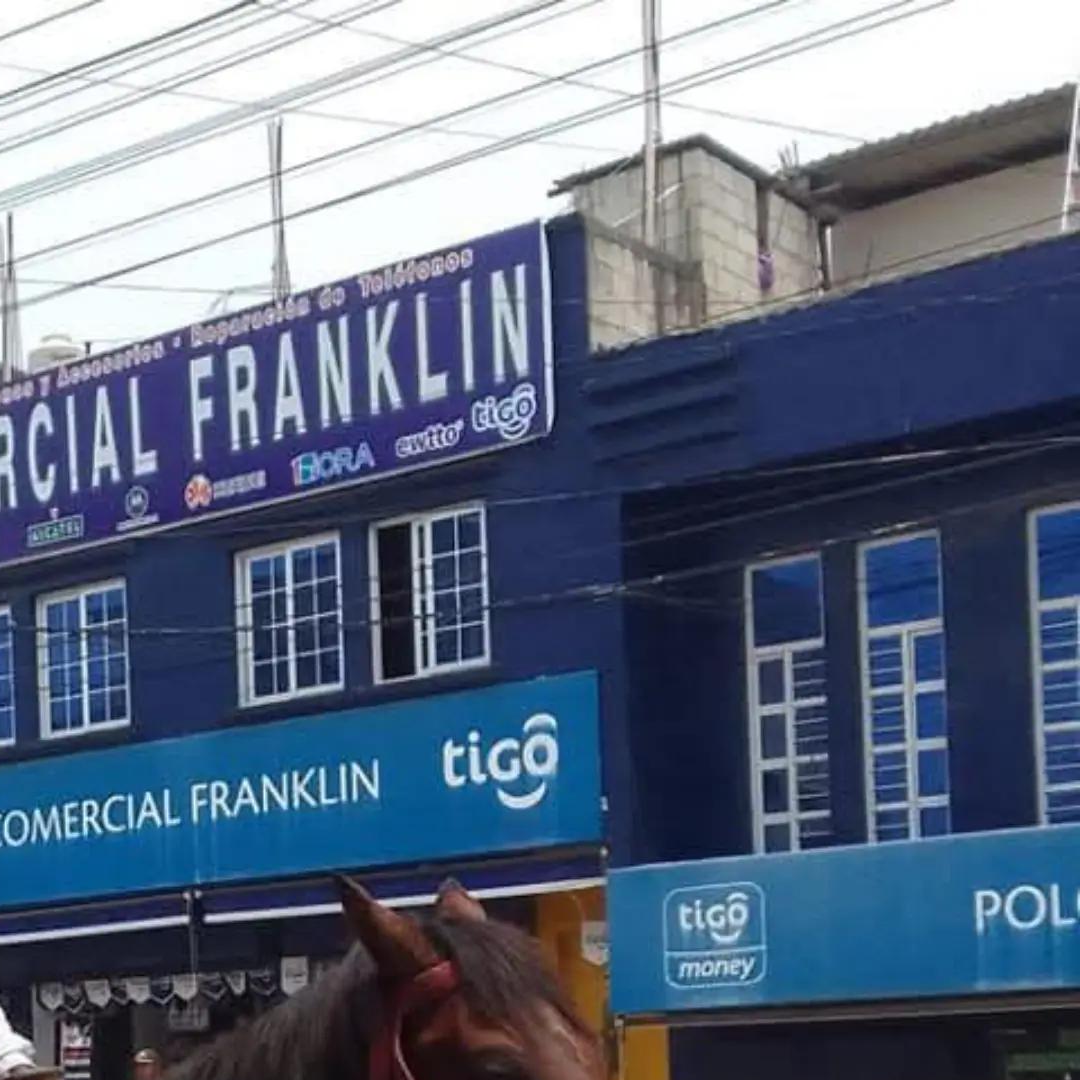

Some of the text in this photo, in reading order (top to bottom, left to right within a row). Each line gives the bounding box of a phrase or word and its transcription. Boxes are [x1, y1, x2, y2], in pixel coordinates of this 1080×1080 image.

[320, 286, 345, 311] de
[189, 263, 530, 461] FRANKLIN
[443, 713, 559, 809] tigo
[191, 759, 380, 823] FRANKLIN
[678, 892, 749, 944] tigo
[678, 955, 756, 981] money
